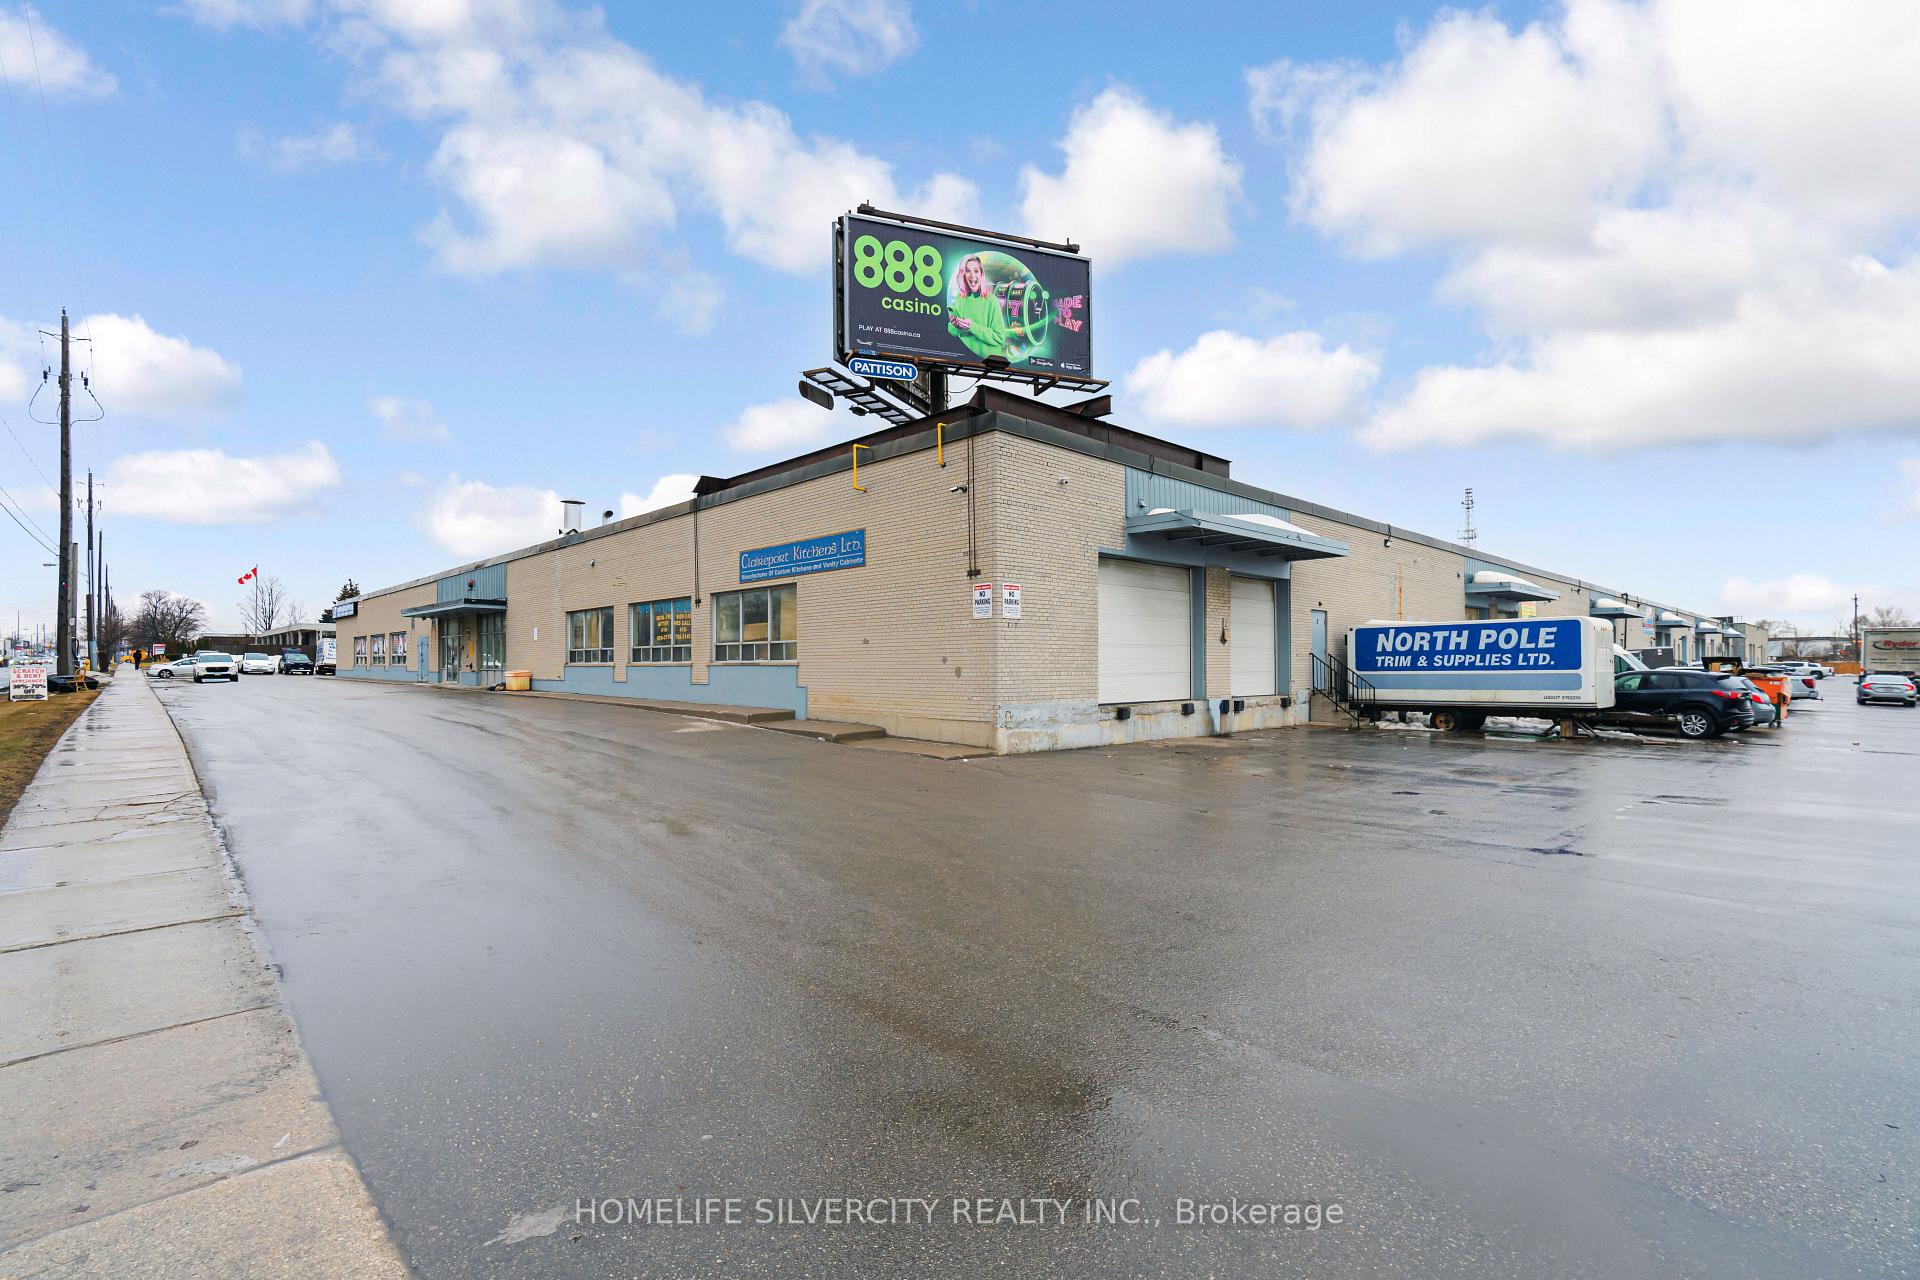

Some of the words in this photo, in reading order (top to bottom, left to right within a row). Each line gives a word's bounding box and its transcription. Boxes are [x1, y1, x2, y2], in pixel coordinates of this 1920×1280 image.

[854, 235, 943, 297] 888
[881, 297, 942, 316] casino
[858, 324, 873, 332] PLAY
[854, 361, 912, 378] PATTISON
[1376, 629, 1469, 652] NORTH
[1478, 626, 1558, 650] POLE
[1883, 639, 1917, 648] Ryder
[1375, 655, 1412, 668] TRIM
[1417, 655, 1428, 667] &
[1433, 653, 1513, 667] SUPPLIES
[1517, 652, 1555, 666] LTD.
